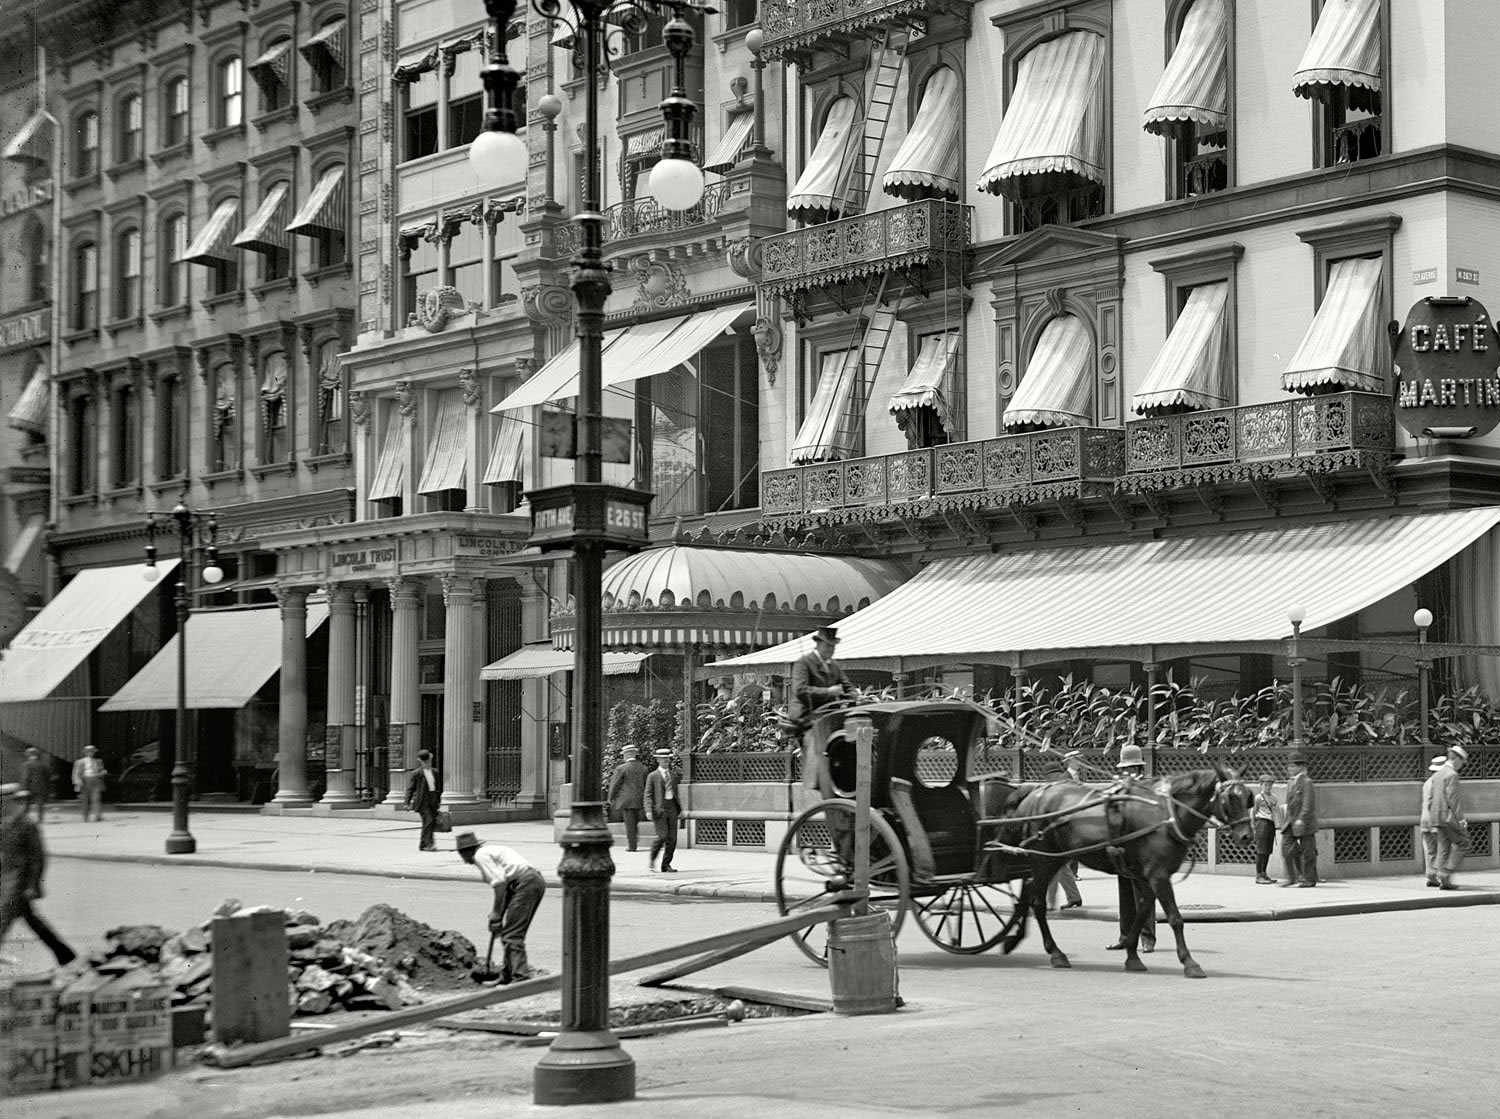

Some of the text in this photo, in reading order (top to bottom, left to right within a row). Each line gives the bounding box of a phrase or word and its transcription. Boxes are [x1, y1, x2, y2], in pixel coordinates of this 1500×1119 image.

[1411, 314, 1489, 352] CAFÉ
[1399, 378, 1500, 408] MARTIN
[535, 508, 557, 529] FIFTH
[606, 506, 614, 525] E
[615, 508, 630, 527] 26
[459, 538, 506, 550] LINCOLN
[332, 548, 396, 567] LINCOLN TRUST
